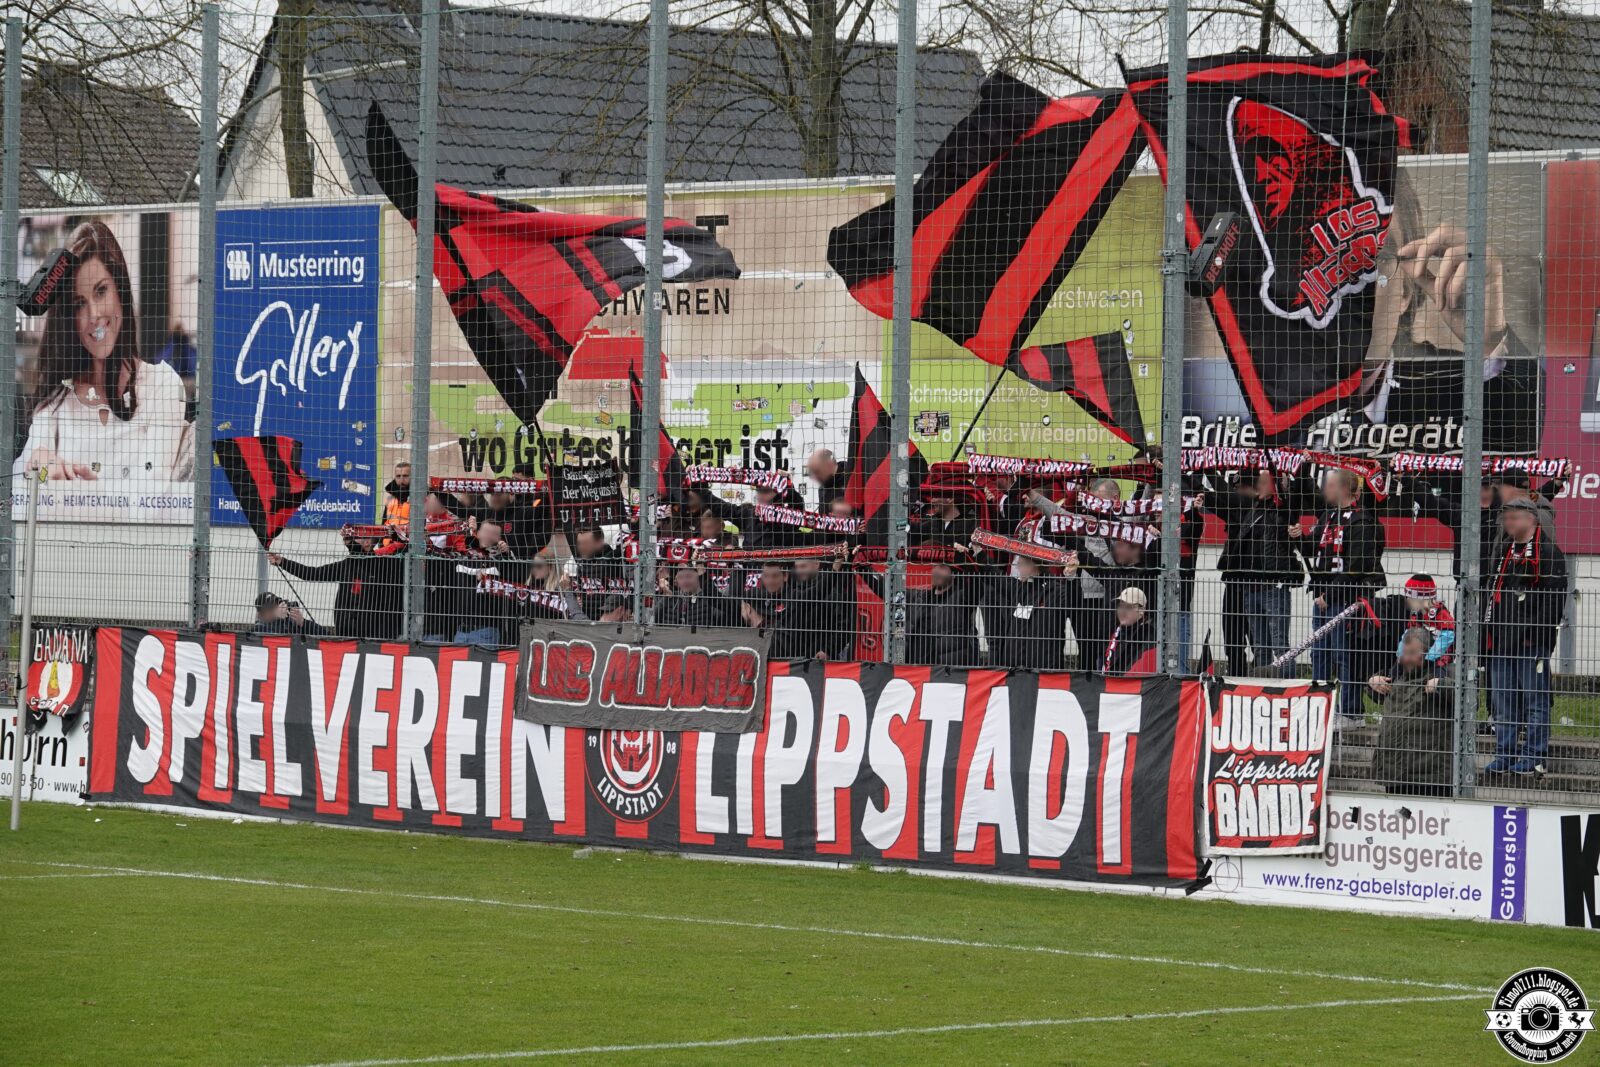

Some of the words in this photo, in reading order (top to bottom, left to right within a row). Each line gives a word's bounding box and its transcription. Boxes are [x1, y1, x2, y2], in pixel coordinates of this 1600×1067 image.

[260, 250, 364, 282] Musterring
[1047, 287, 1143, 309] urstwaren
[235, 301, 363, 436] Gallery
[459, 437, 507, 473] wo
[513, 425, 613, 474] Gutes
[740, 424, 789, 471] ist
[1181, 416, 1257, 447] Brille
[63, 494, 129, 508] HEIMTEXTILIEN
[218, 497, 244, 513] Haup
[34, 629, 88, 664] BANANA
[527, 639, 597, 705] LOS
[599, 643, 760, 713] ALIADOS
[1213, 694, 1327, 752] JUGEND
[127, 635, 565, 822] SPIELVEREIN
[696, 676, 1142, 864] LIPPSTADT
[587, 735, 597, 748] 19
[666, 742, 677, 755] 08
[1215, 753, 1320, 785] Lippstadt
[597, 777, 663, 816] LIPPSTADT
[1215, 783, 1318, 838] BANDE
[1327, 804, 1450, 840] belstapler
[1322, 838, 1483, 873] gungsgeräte
[1500, 807, 1518, 920] Gütersloh
[1262, 872, 1483, 901] www.frenz-gabelstapler.de
